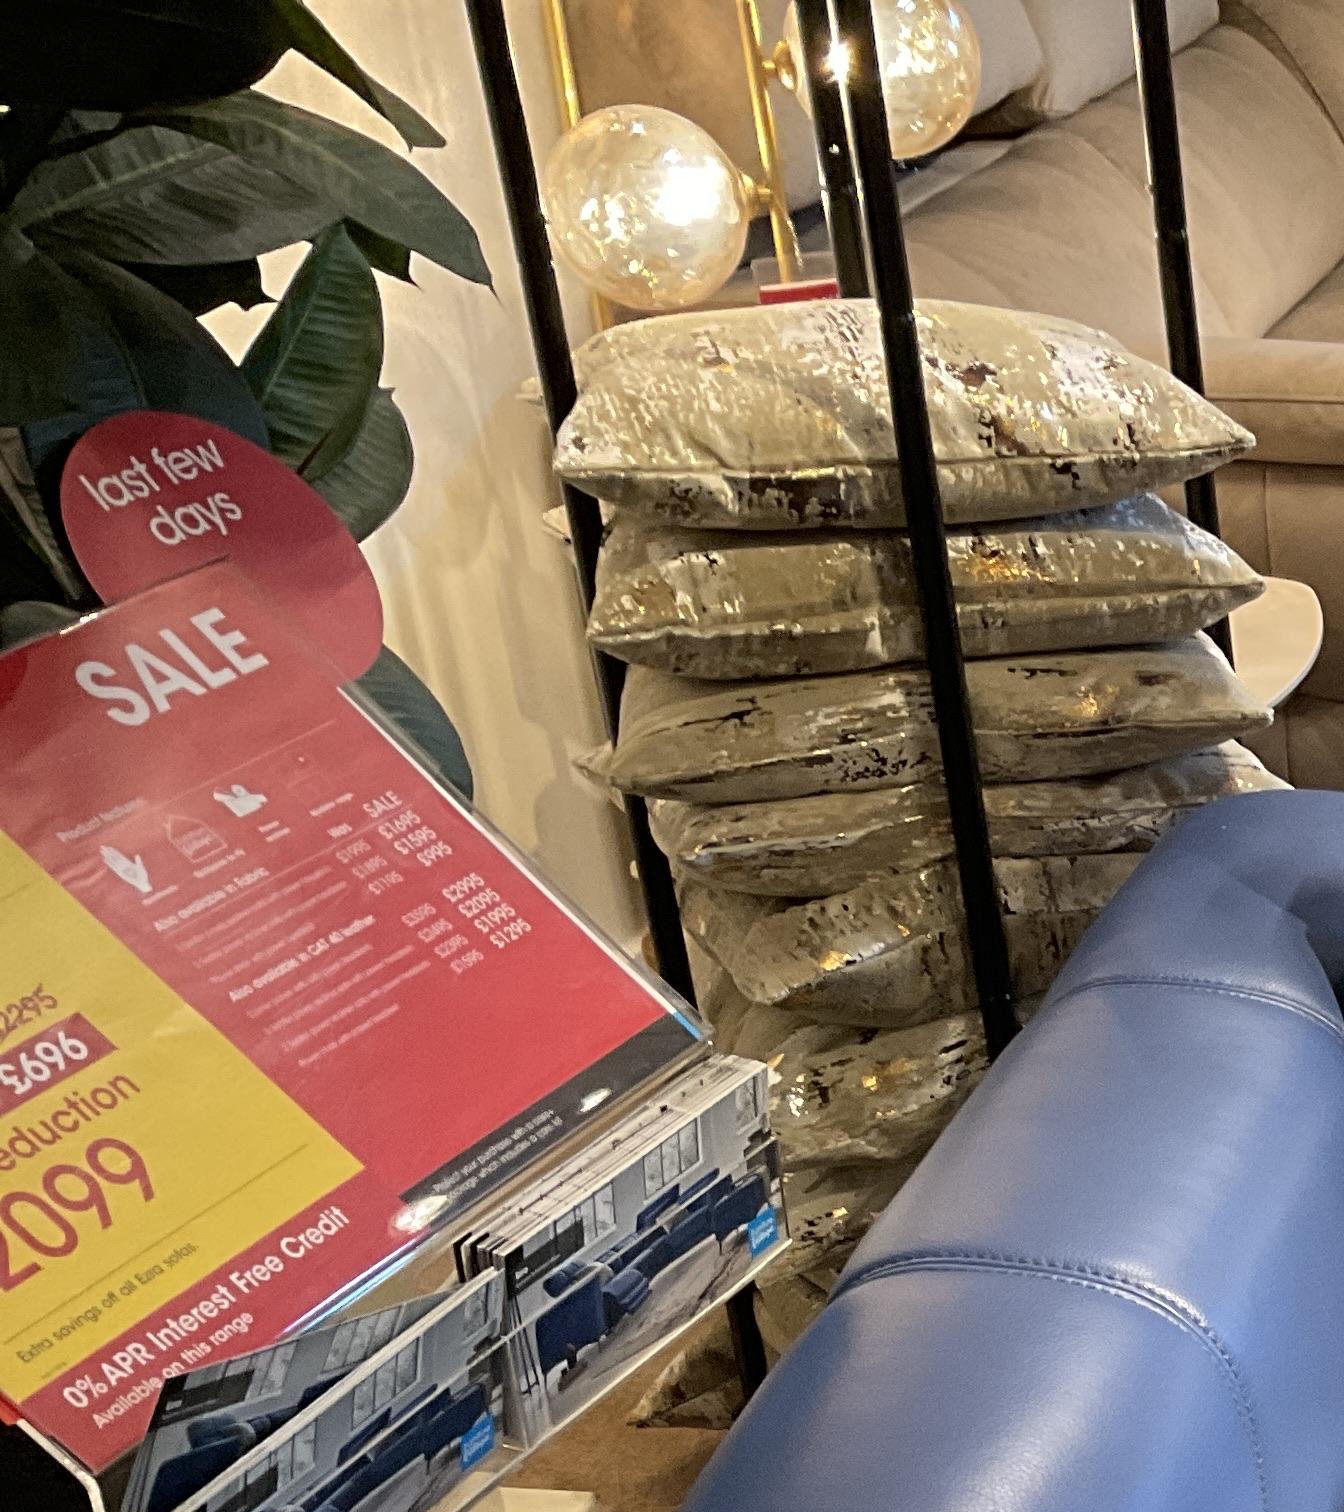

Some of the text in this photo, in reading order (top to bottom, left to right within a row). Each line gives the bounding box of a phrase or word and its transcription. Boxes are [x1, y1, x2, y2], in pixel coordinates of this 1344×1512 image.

[79, 438, 225, 511] last few
[150, 492, 242, 545] days
[75, 606, 269, 726] SALE
[362, 790, 402, 818] SALE
[377, 809, 421, 840] £1695
[393, 825, 437, 855] £1595
[416, 841, 453, 867] £995
[441, 872, 486, 903] £2995
[458, 887, 502, 918] £2095
[474, 902, 516, 934] £1995
[489, 918, 532, 949] £1295
[0, 1030, 89, 1096] £696
[62, 1373, 109, 1409] 0%
[101, 1340, 155, 1387] APR
[146, 1284, 237, 1352] Interest
[229, 1254, 285, 1295] Free
[279, 1205, 350, 1259] Credit
[16, 1338, 54, 1364] Extra
[52, 1304, 102, 1342] savings
[92, 1311, 255, 1430] Available on this range
